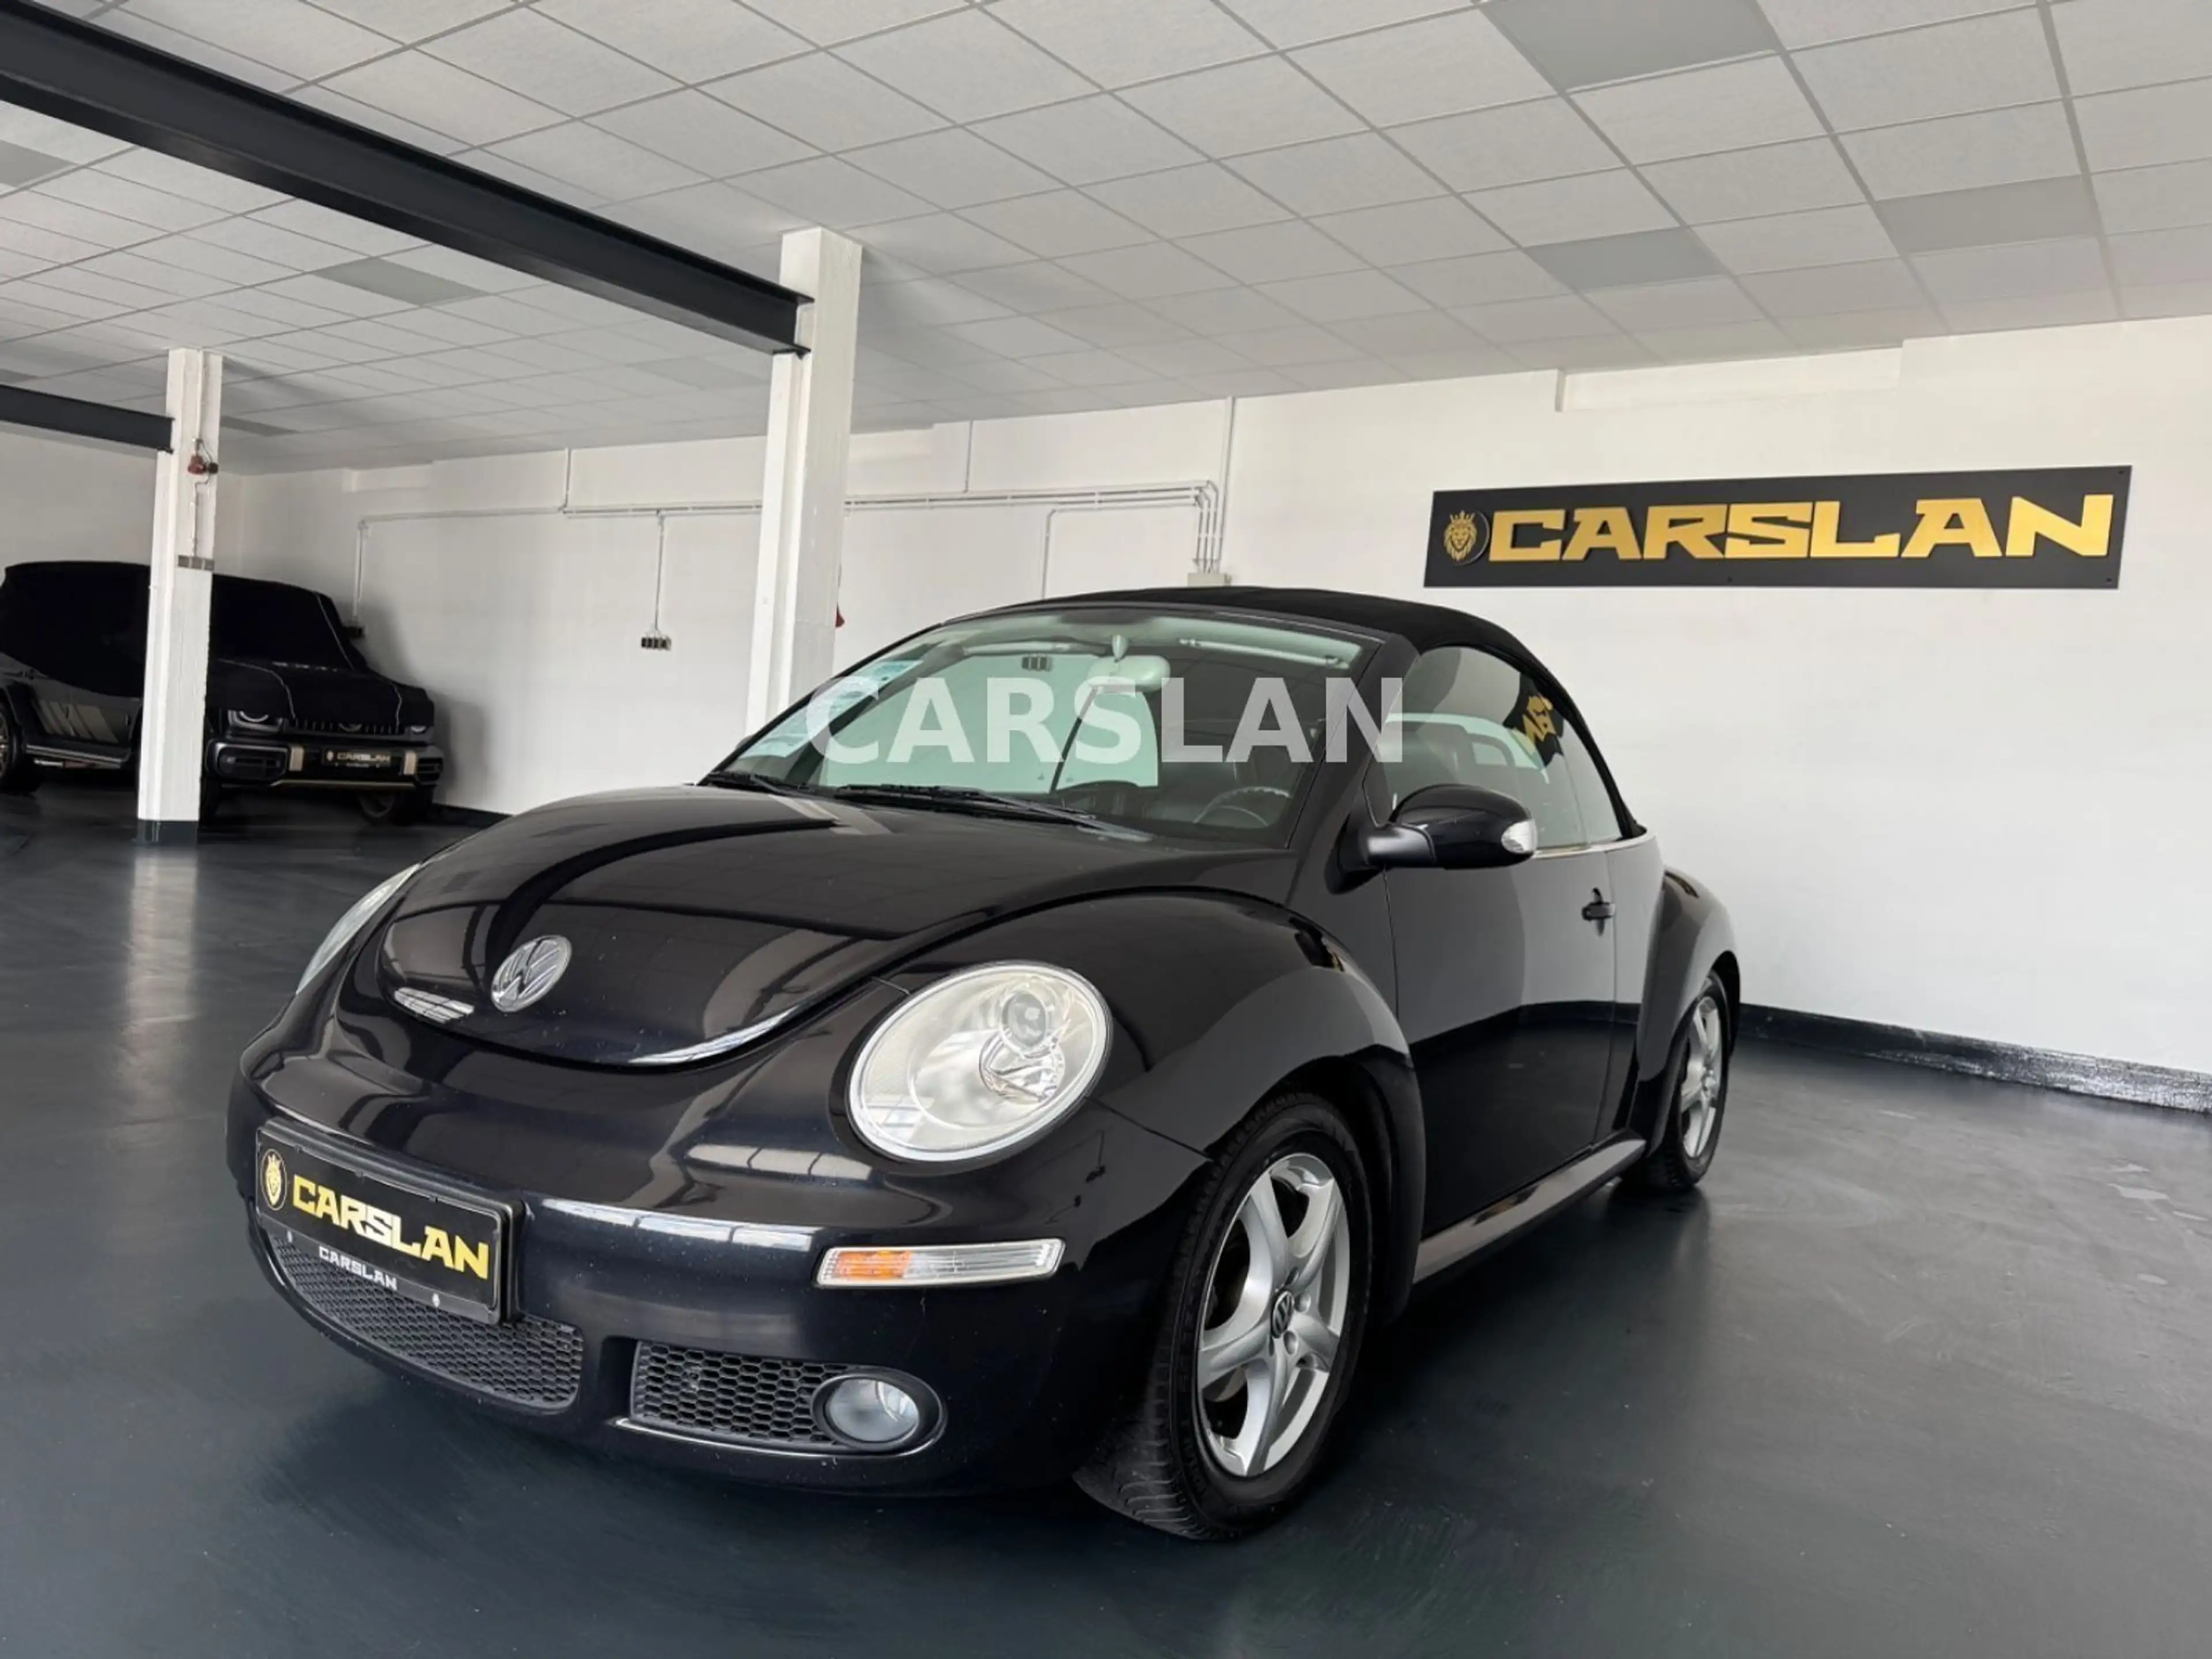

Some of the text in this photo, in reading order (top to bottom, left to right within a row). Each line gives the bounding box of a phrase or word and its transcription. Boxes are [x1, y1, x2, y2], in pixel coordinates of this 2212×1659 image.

[1488, 494, 2113, 561] CARSLAN
[293, 1174, 489, 1280] CARSLAN
[319, 1245, 398, 1291] CARSLAN
